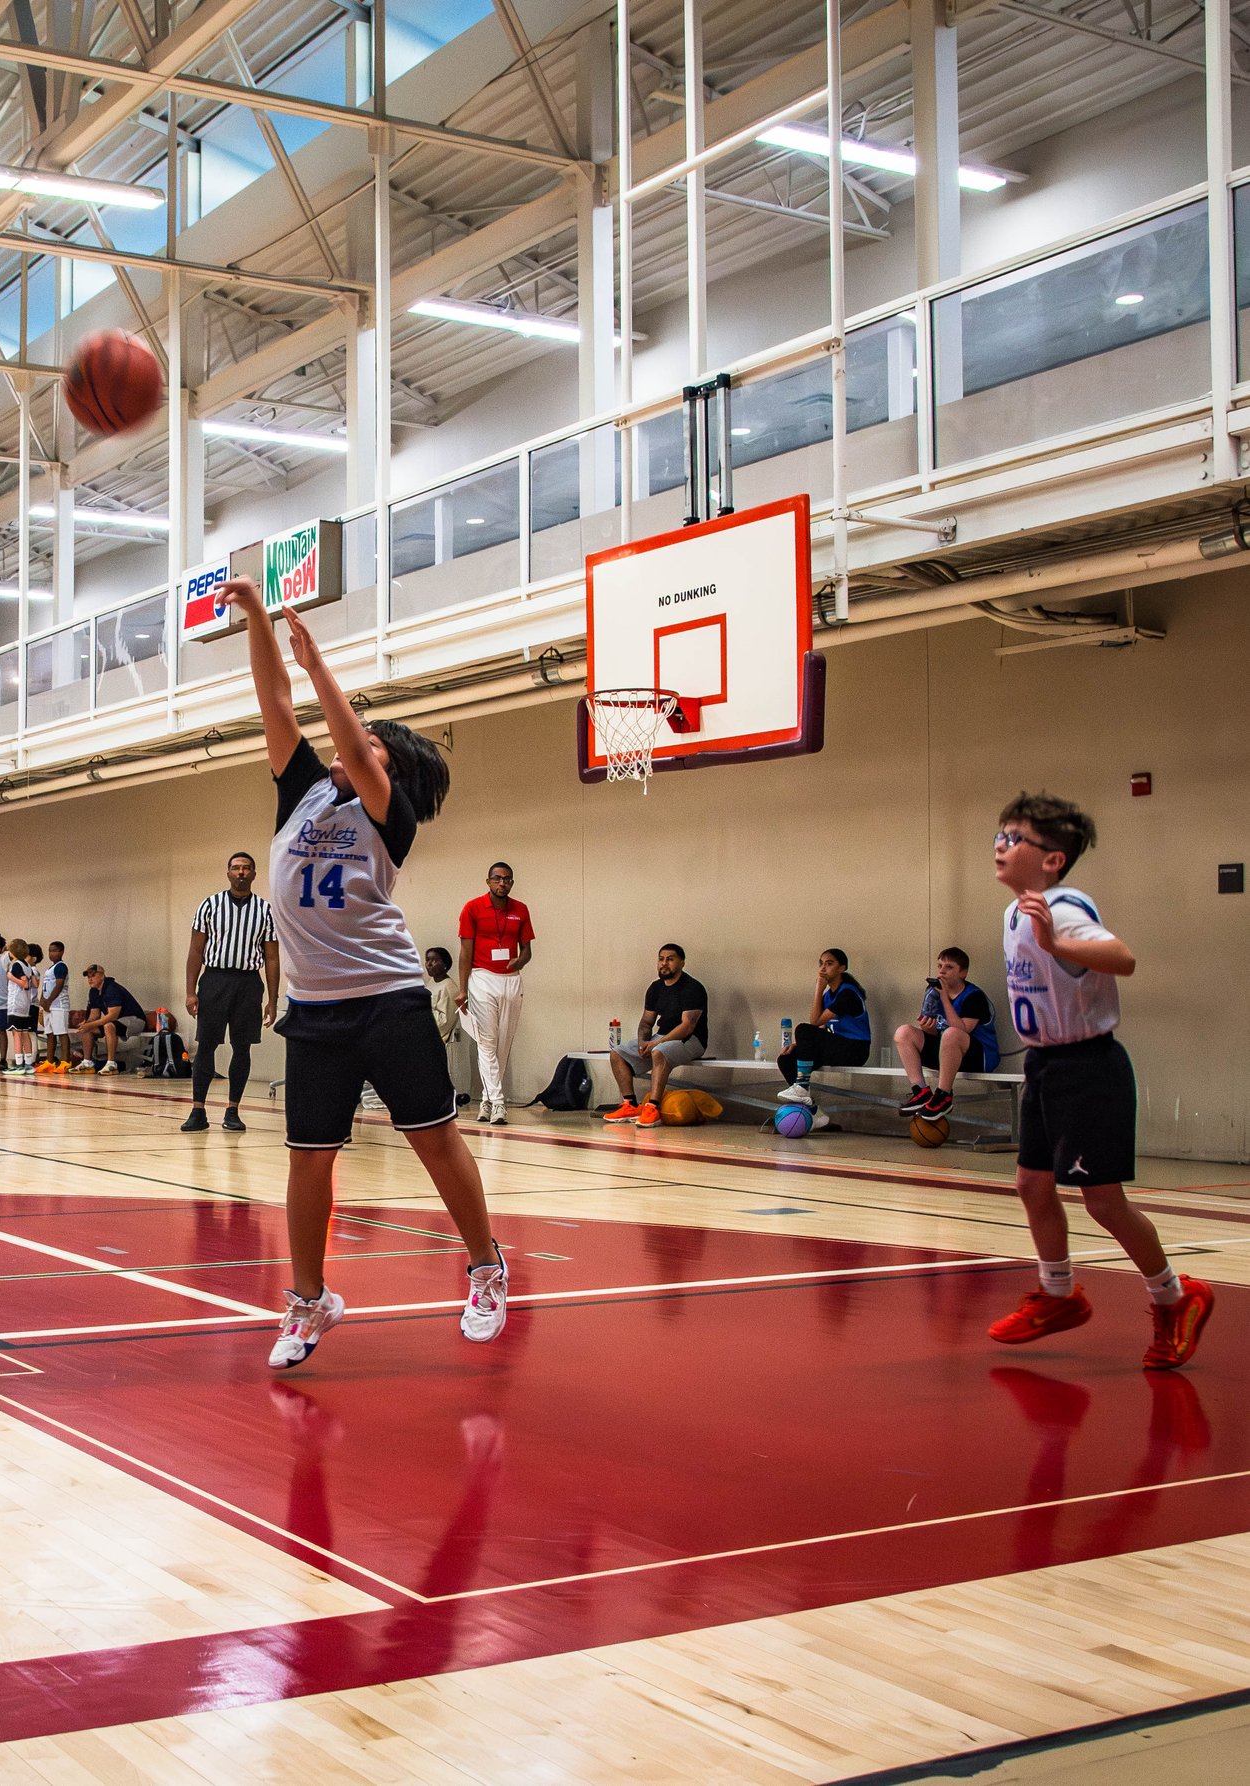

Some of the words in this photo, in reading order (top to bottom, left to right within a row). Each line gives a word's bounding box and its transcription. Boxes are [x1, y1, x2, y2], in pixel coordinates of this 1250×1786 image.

[658, 595, 671, 607] NO
[674, 583, 717, 604] DUNKING
[297, 818, 358, 850] Rowlett
[299, 863, 345, 909] 14
